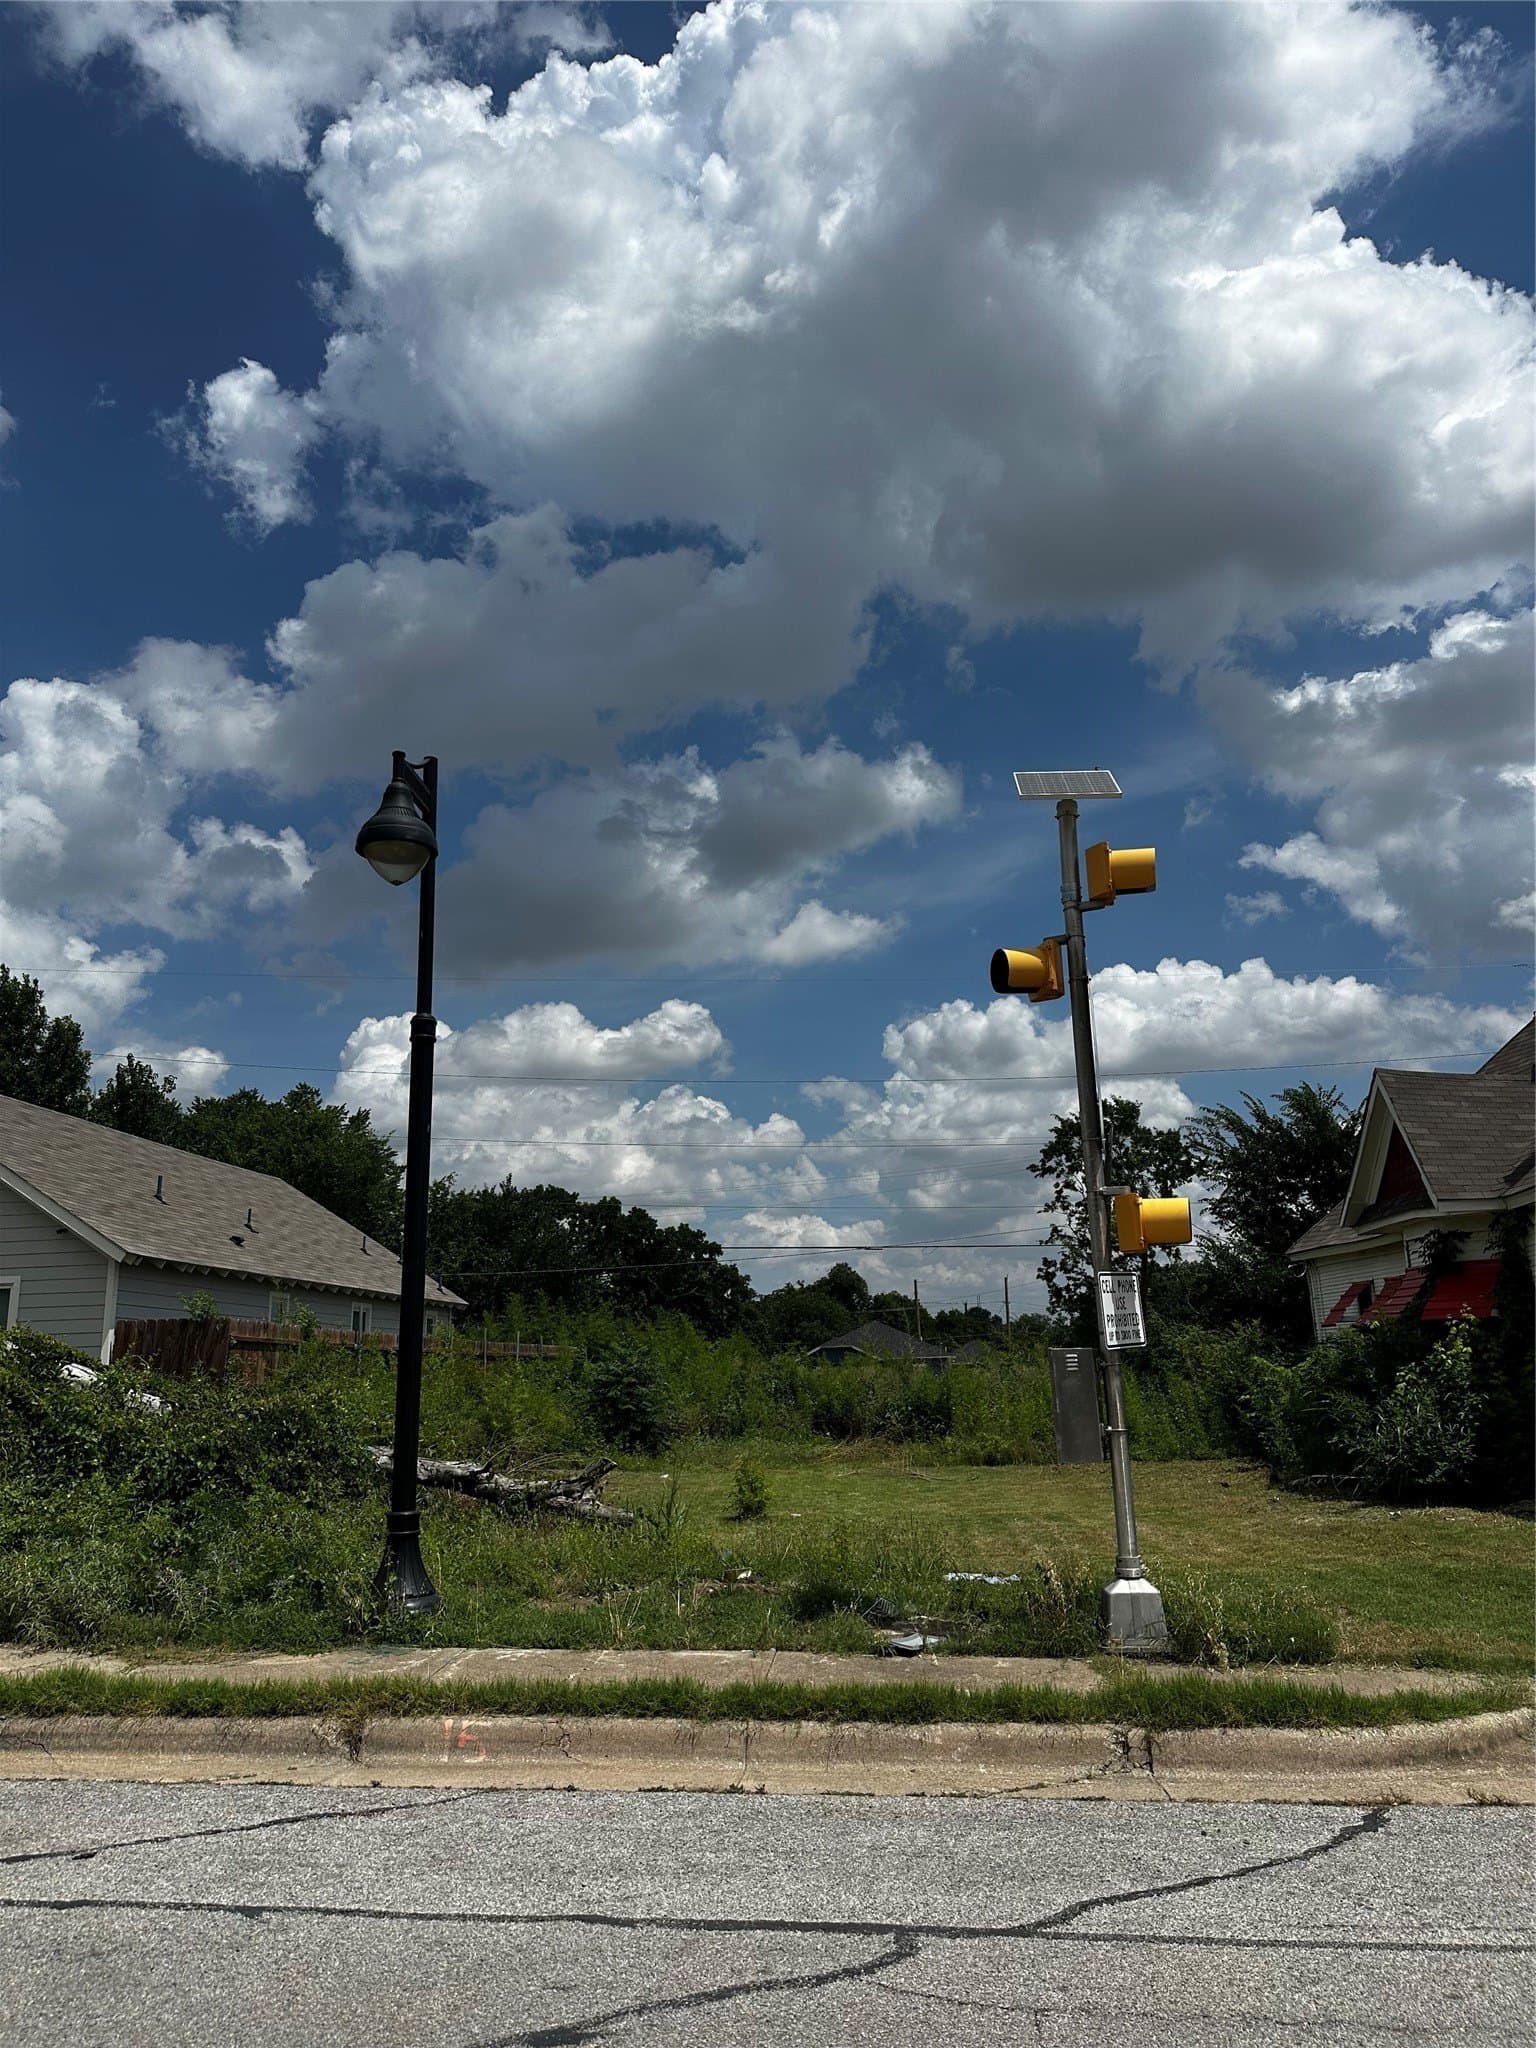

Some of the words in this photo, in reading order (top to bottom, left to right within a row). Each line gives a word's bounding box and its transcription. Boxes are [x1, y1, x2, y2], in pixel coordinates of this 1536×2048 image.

[1102, 1280, 1116, 1293] CELL
[1117, 1280, 1137, 1293] PHONE
[1116, 1296, 1127, 1310] USE
[1106, 1313, 1139, 1328] PROHIBITED
